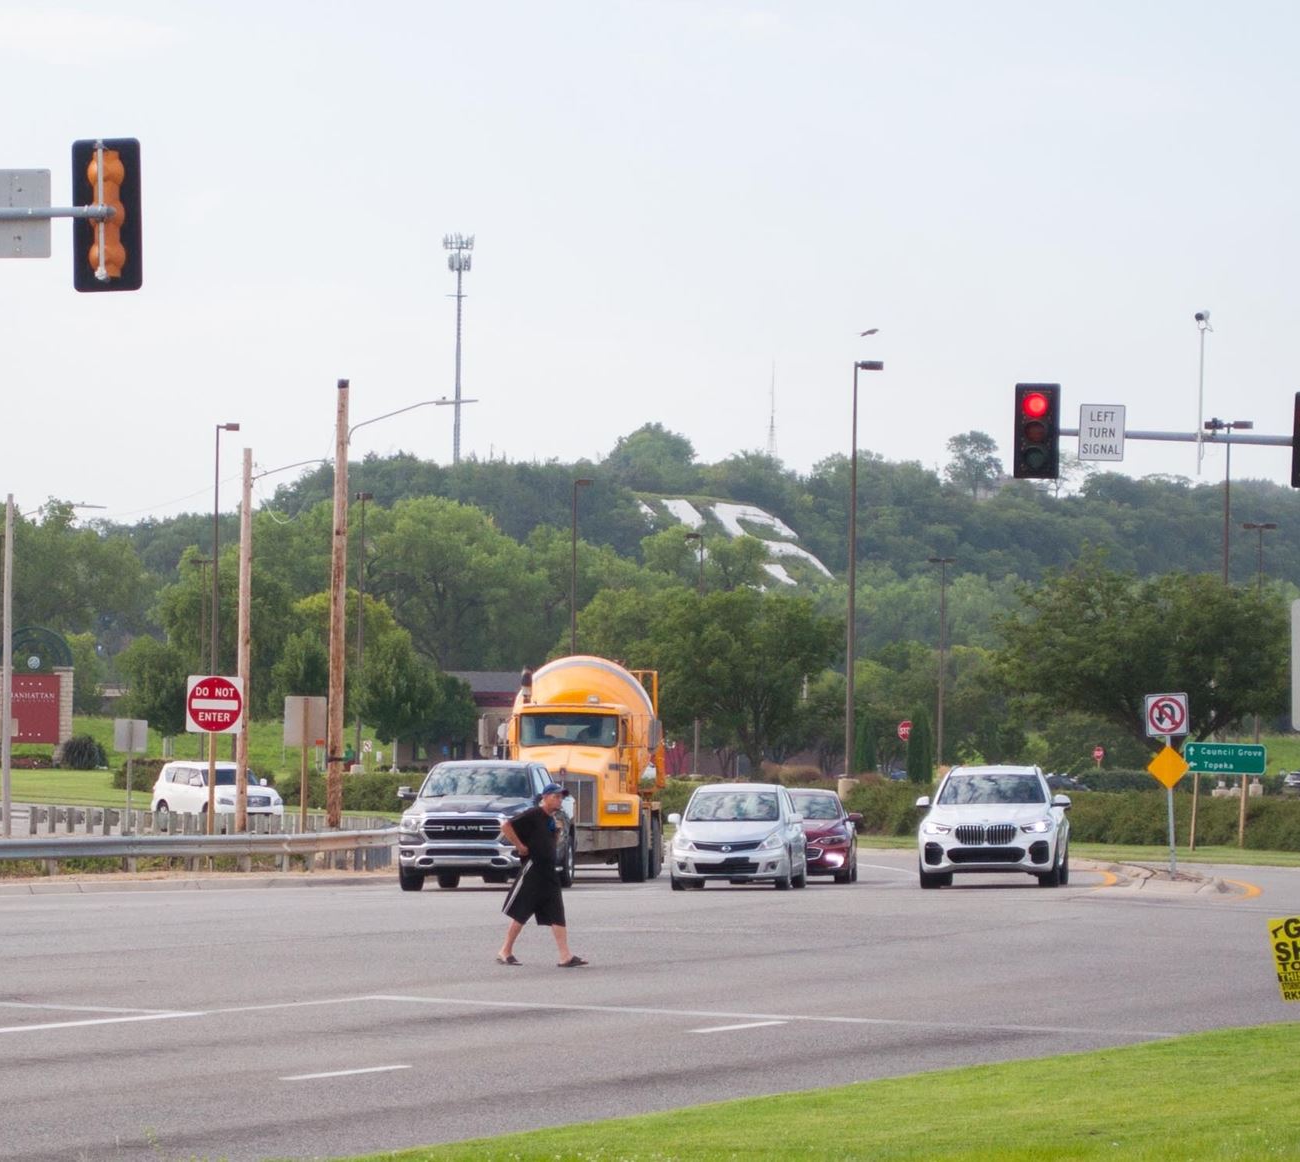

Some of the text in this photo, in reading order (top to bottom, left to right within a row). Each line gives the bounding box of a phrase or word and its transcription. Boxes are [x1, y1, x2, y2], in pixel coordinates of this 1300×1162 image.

[1090, 410, 1116, 422] LEFT
[1088, 427, 1116, 438] TURN
[1082, 443, 1121, 455] SIGNAL
[195, 686, 235, 697] DO NOT
[198, 711, 230, 722] ENTER
[1200, 746, 1262, 757] Council Grove
[1204, 761, 1234, 770] Topeka
[1284, 991, 1300, 1000] RK
